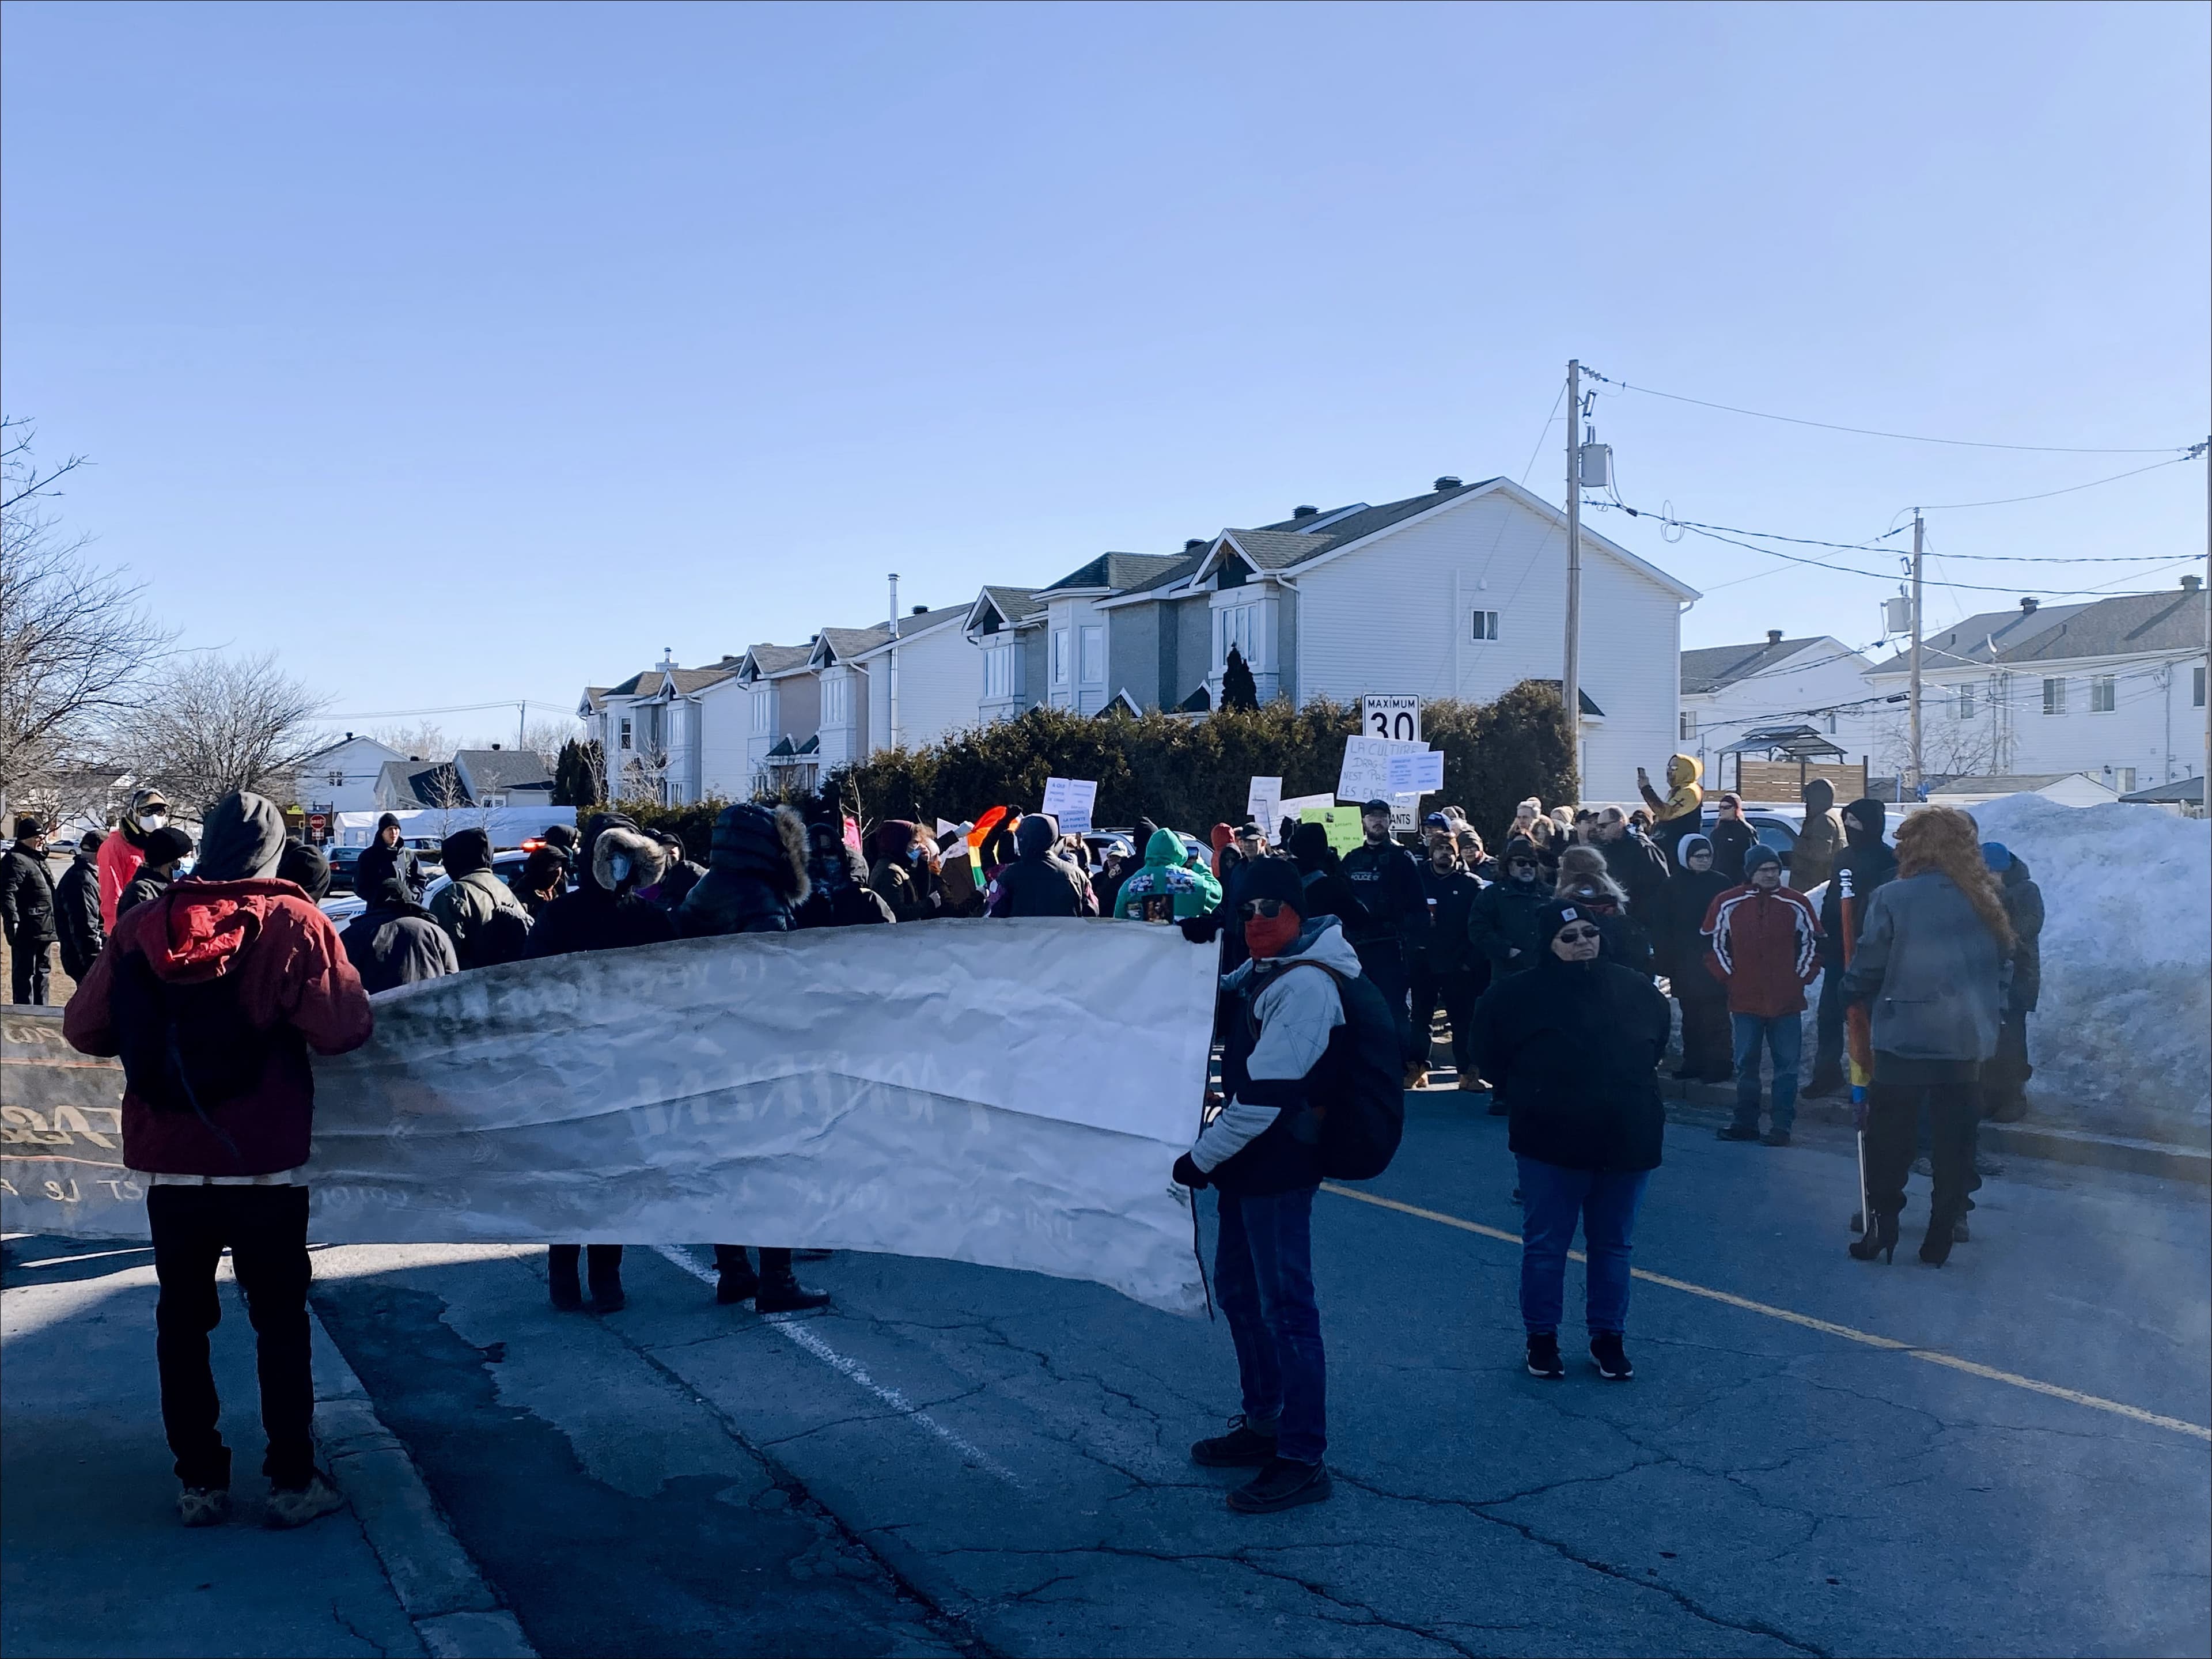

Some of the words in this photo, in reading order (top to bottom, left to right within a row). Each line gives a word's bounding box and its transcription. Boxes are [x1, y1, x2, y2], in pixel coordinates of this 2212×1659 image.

[1368, 699, 1415, 708] MAXIMUM
[1370, 712, 1414, 741] 30
[1350, 741, 1365, 754] LA
[1368, 743, 1418, 756] CULTURE
[1351, 757, 1377, 768] DRAG
[1340, 785, 1357, 797] LES
[1389, 814, 1411, 824] ANTS
